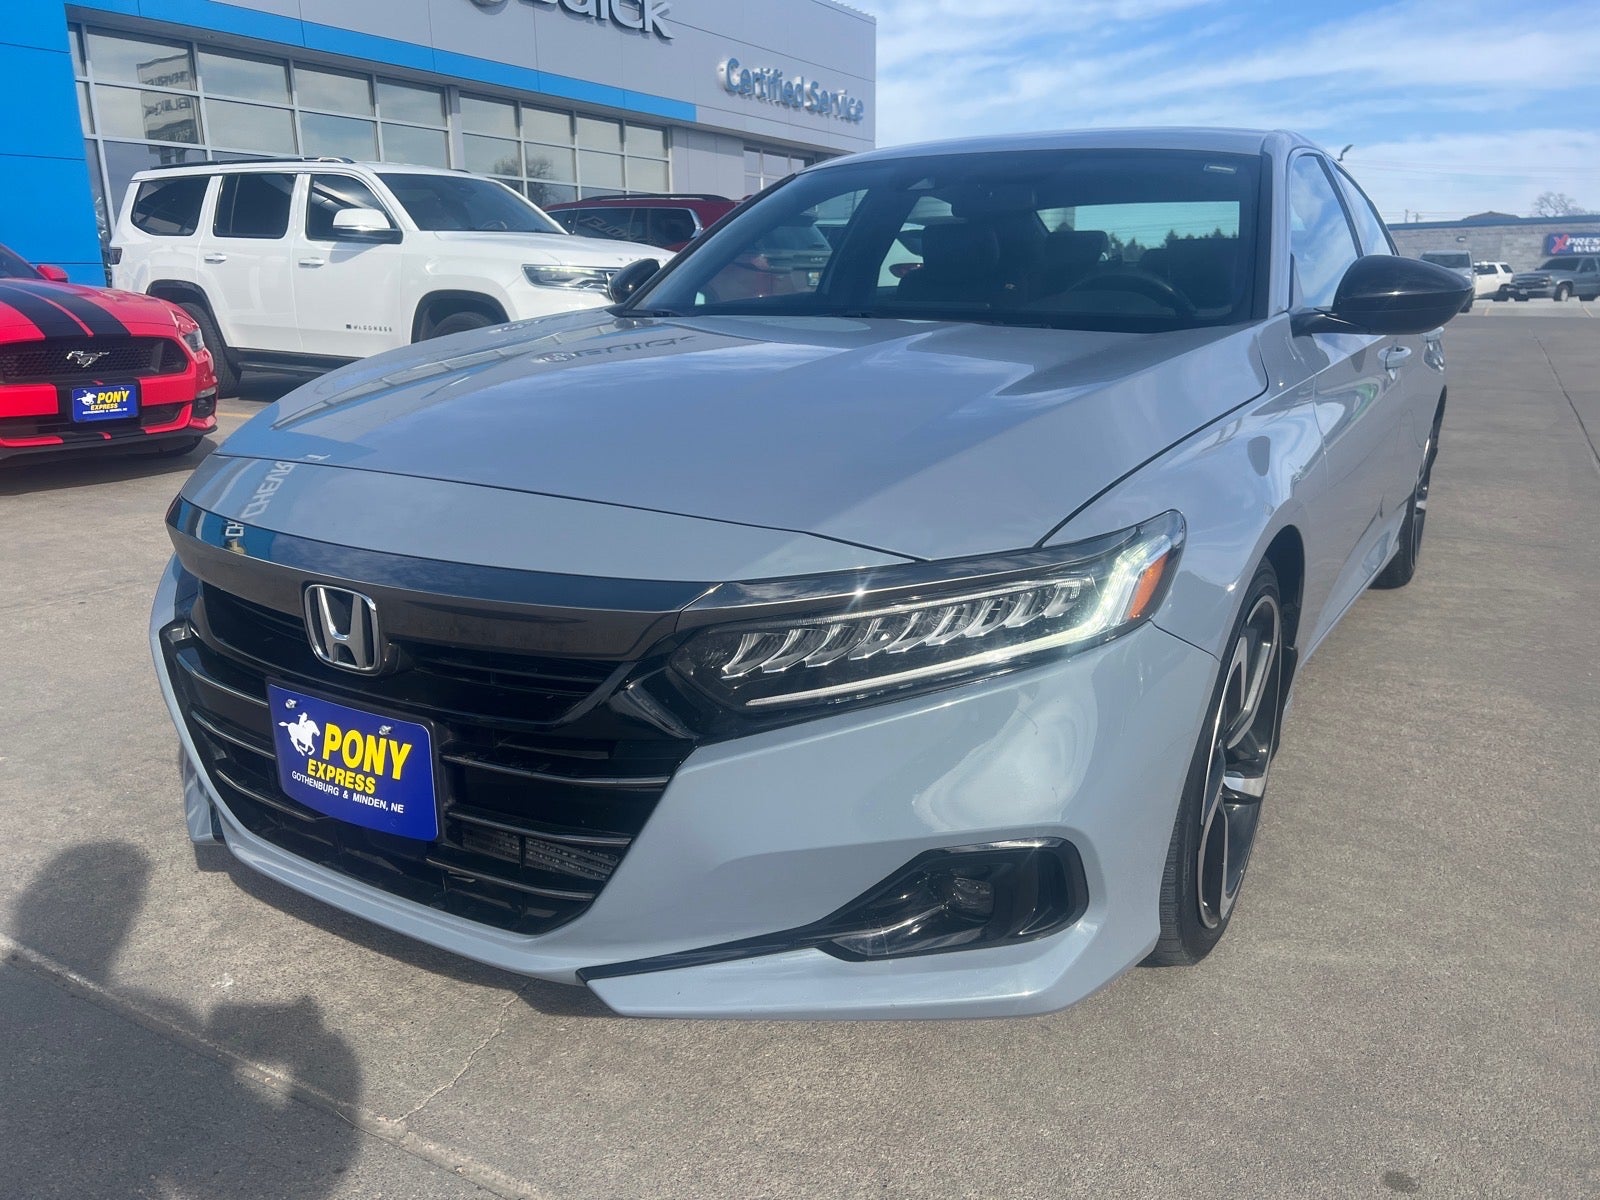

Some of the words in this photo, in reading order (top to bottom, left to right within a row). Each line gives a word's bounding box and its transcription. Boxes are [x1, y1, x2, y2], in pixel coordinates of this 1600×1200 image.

[720, 58, 804, 107] Certified
[804, 80, 864, 120] Service
[90, 403, 118, 411] EXPRESS
[97, 390, 130, 404] PONY
[322, 722, 412, 780] PONY
[291, 770, 339, 796] GOTHENBURG
[342, 790, 349, 799] &
[352, 793, 389, 811] MINDEN,
[391, 803, 405, 813] NE
[307, 758, 376, 794] EXPRESS
